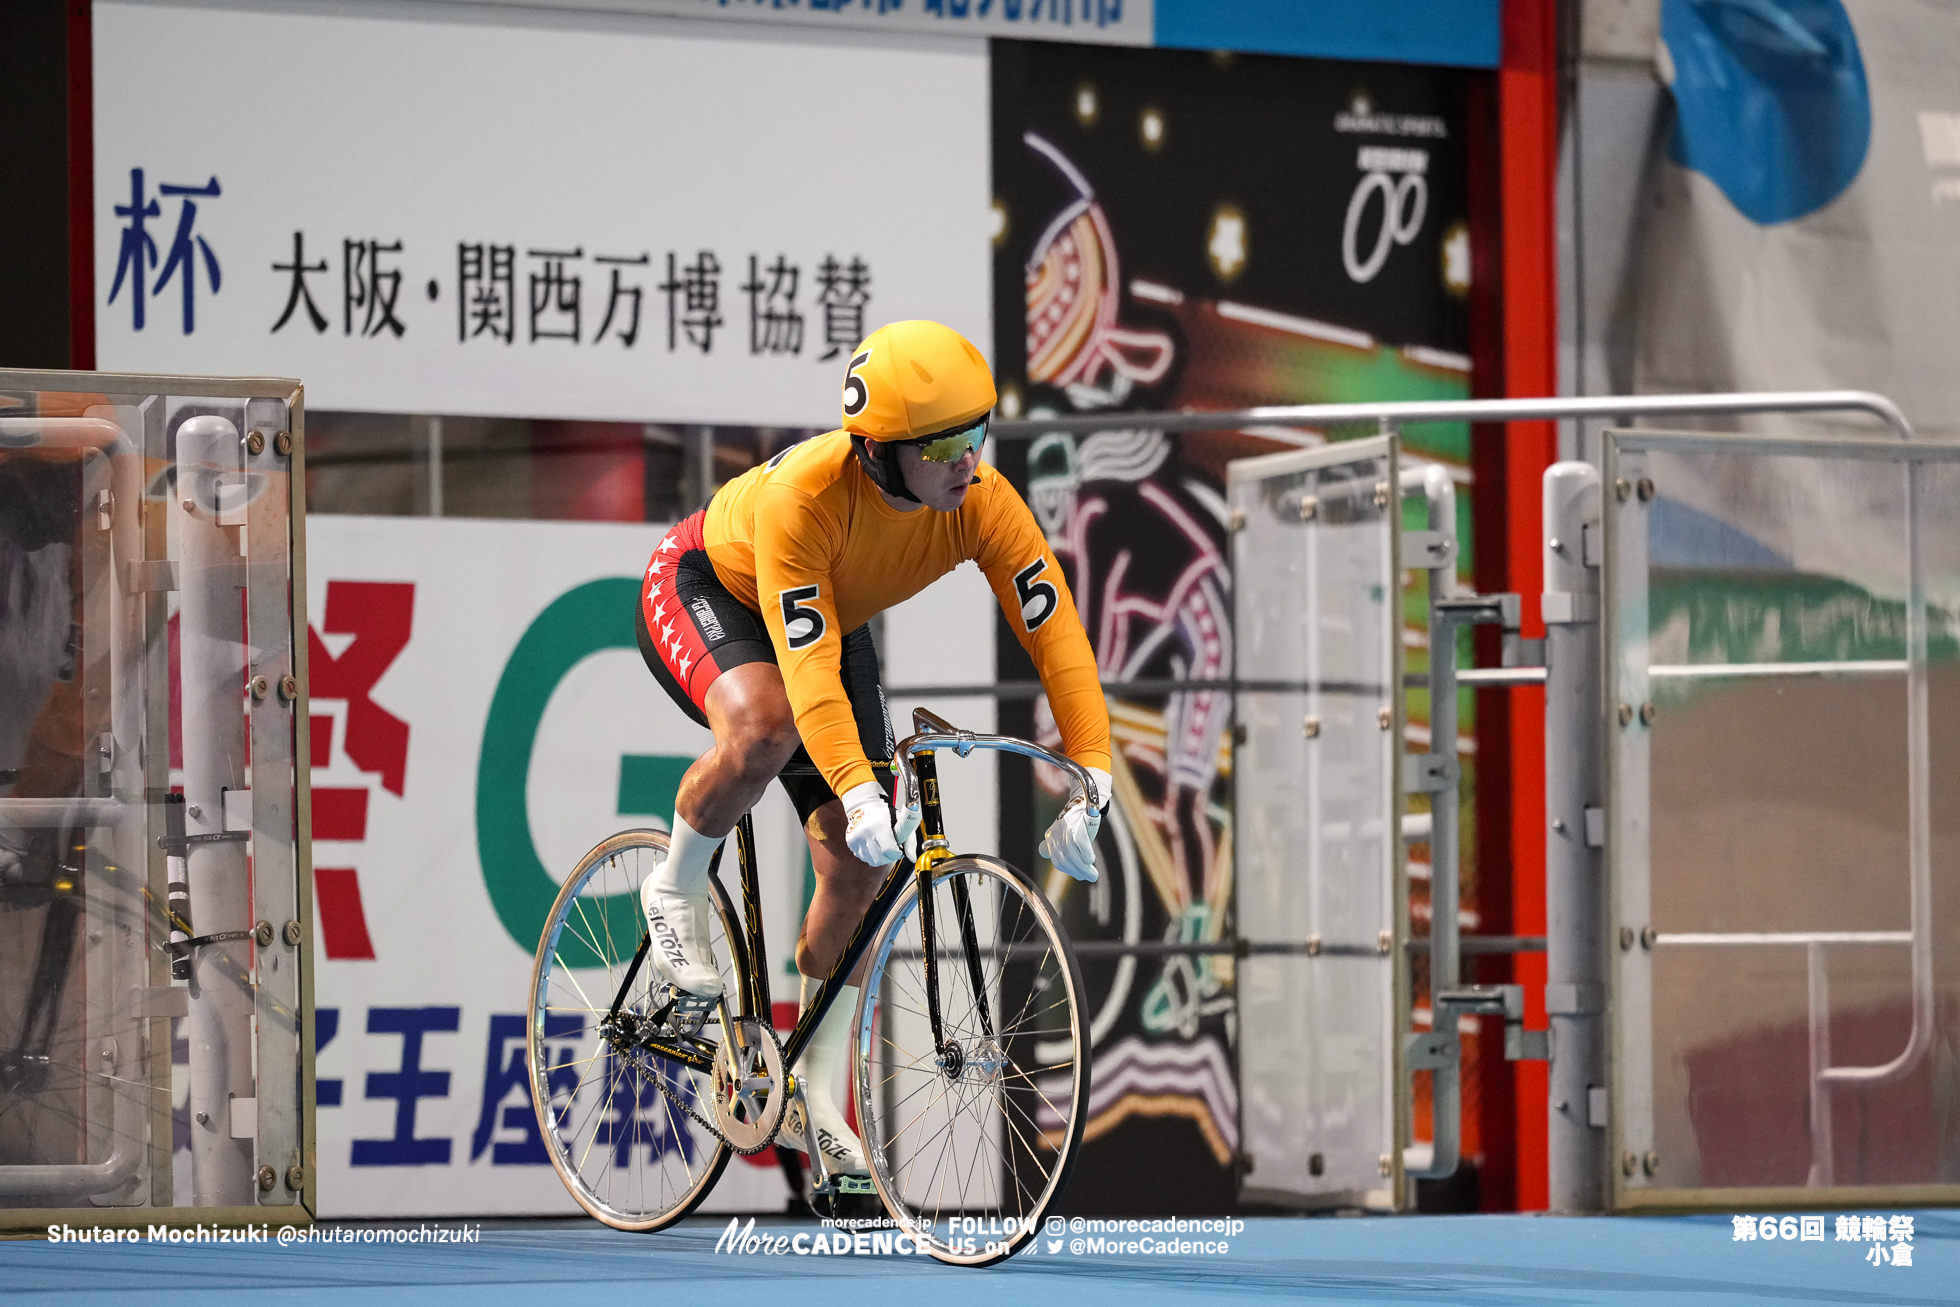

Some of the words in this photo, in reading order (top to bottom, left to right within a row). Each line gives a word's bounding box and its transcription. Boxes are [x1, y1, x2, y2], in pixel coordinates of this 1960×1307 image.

[107, 167, 221, 336] 杯
[270, 229, 870, 362] 大阪・関西万博協賛
[843, 350, 871, 417] 5
[779, 584, 827, 651] 5
[1012, 555, 1059, 633] 5
